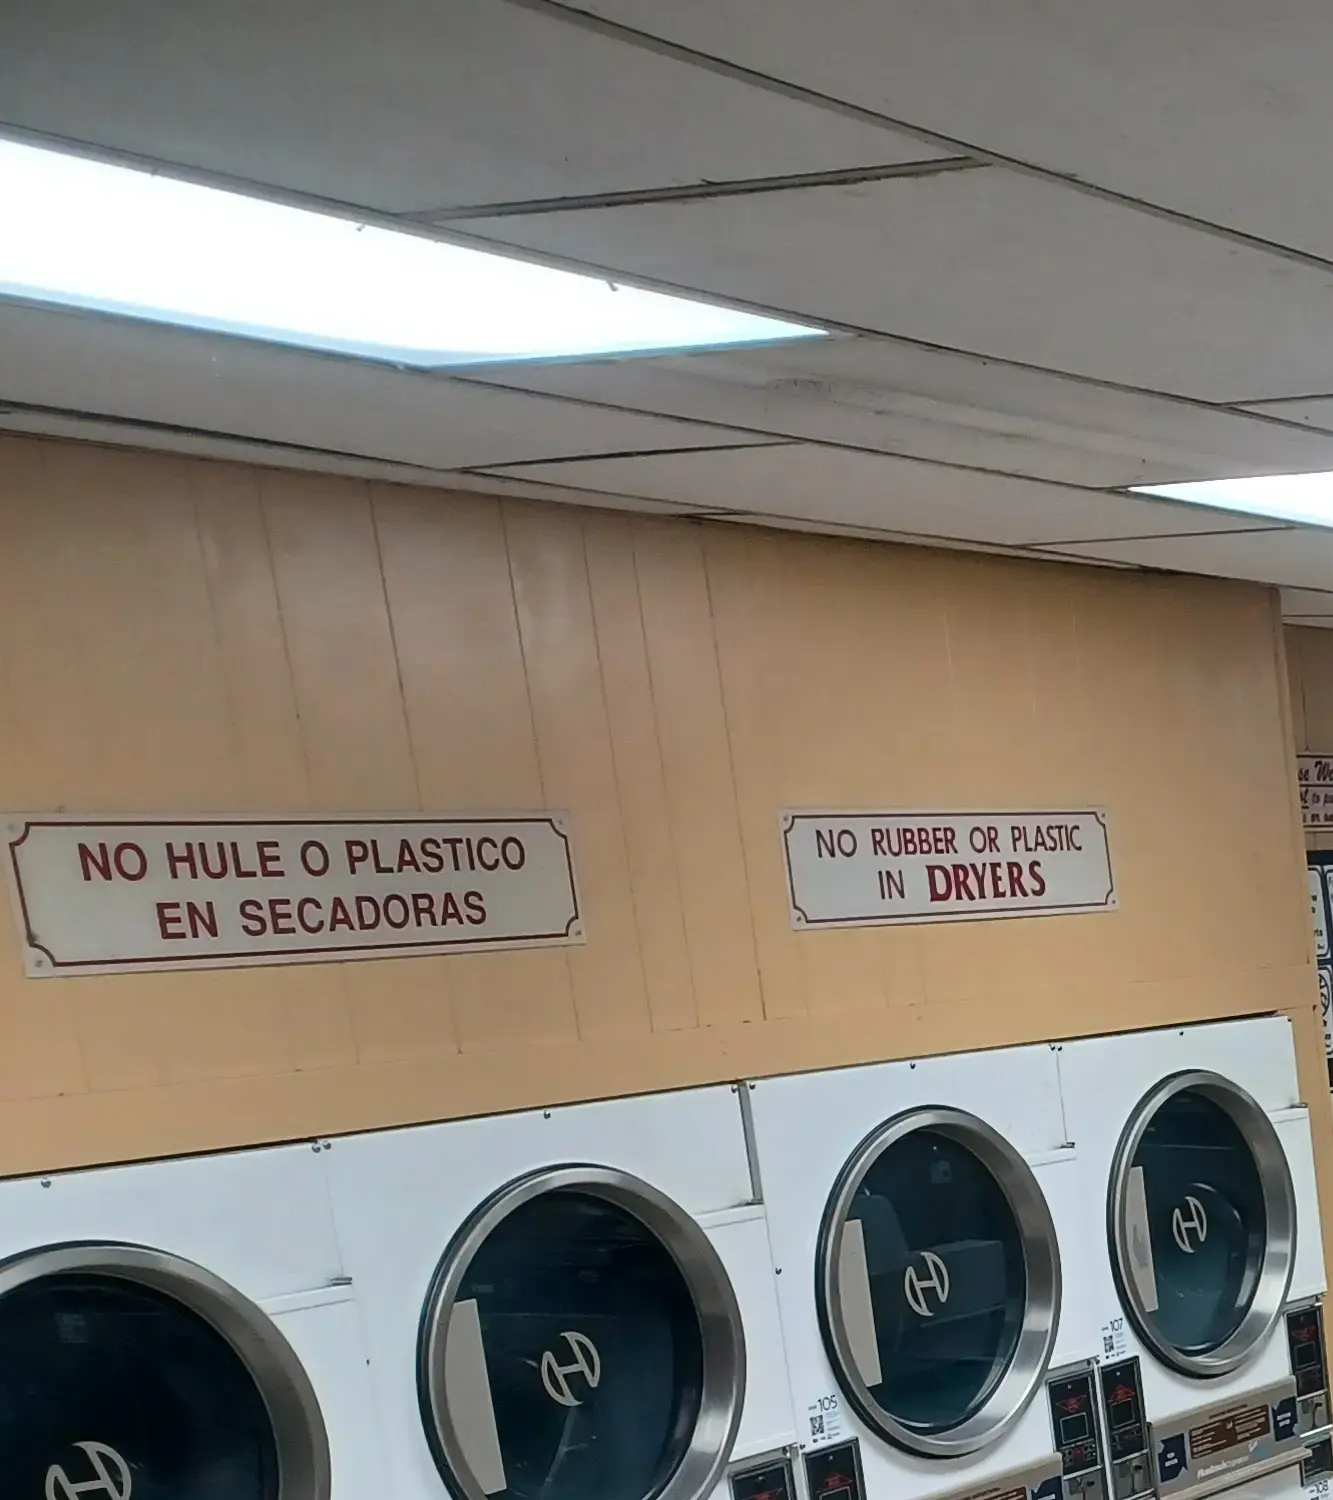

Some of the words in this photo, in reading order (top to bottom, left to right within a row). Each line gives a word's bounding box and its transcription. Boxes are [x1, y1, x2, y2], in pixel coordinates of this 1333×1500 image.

[78, 839, 148, 881] NO
[167, 836, 286, 880] HULE
[298, 839, 331, 878] O
[345, 836, 527, 876] PLASTICO
[813, 825, 858, 859] NO
[870, 823, 958, 857] RUBBER
[968, 823, 1001, 856] OR
[1010, 821, 1084, 854] PLASTIC
[877, 870, 905, 901] IN
[926, 859, 1047, 902] DRYERS
[155, 900, 221, 941] EN
[240, 890, 488, 936] SECADORAS
[1109, 1317, 1124, 1333] 107
[817, 1394, 838, 1412] 105
[1315, 1480, 1329, 1494] 108
